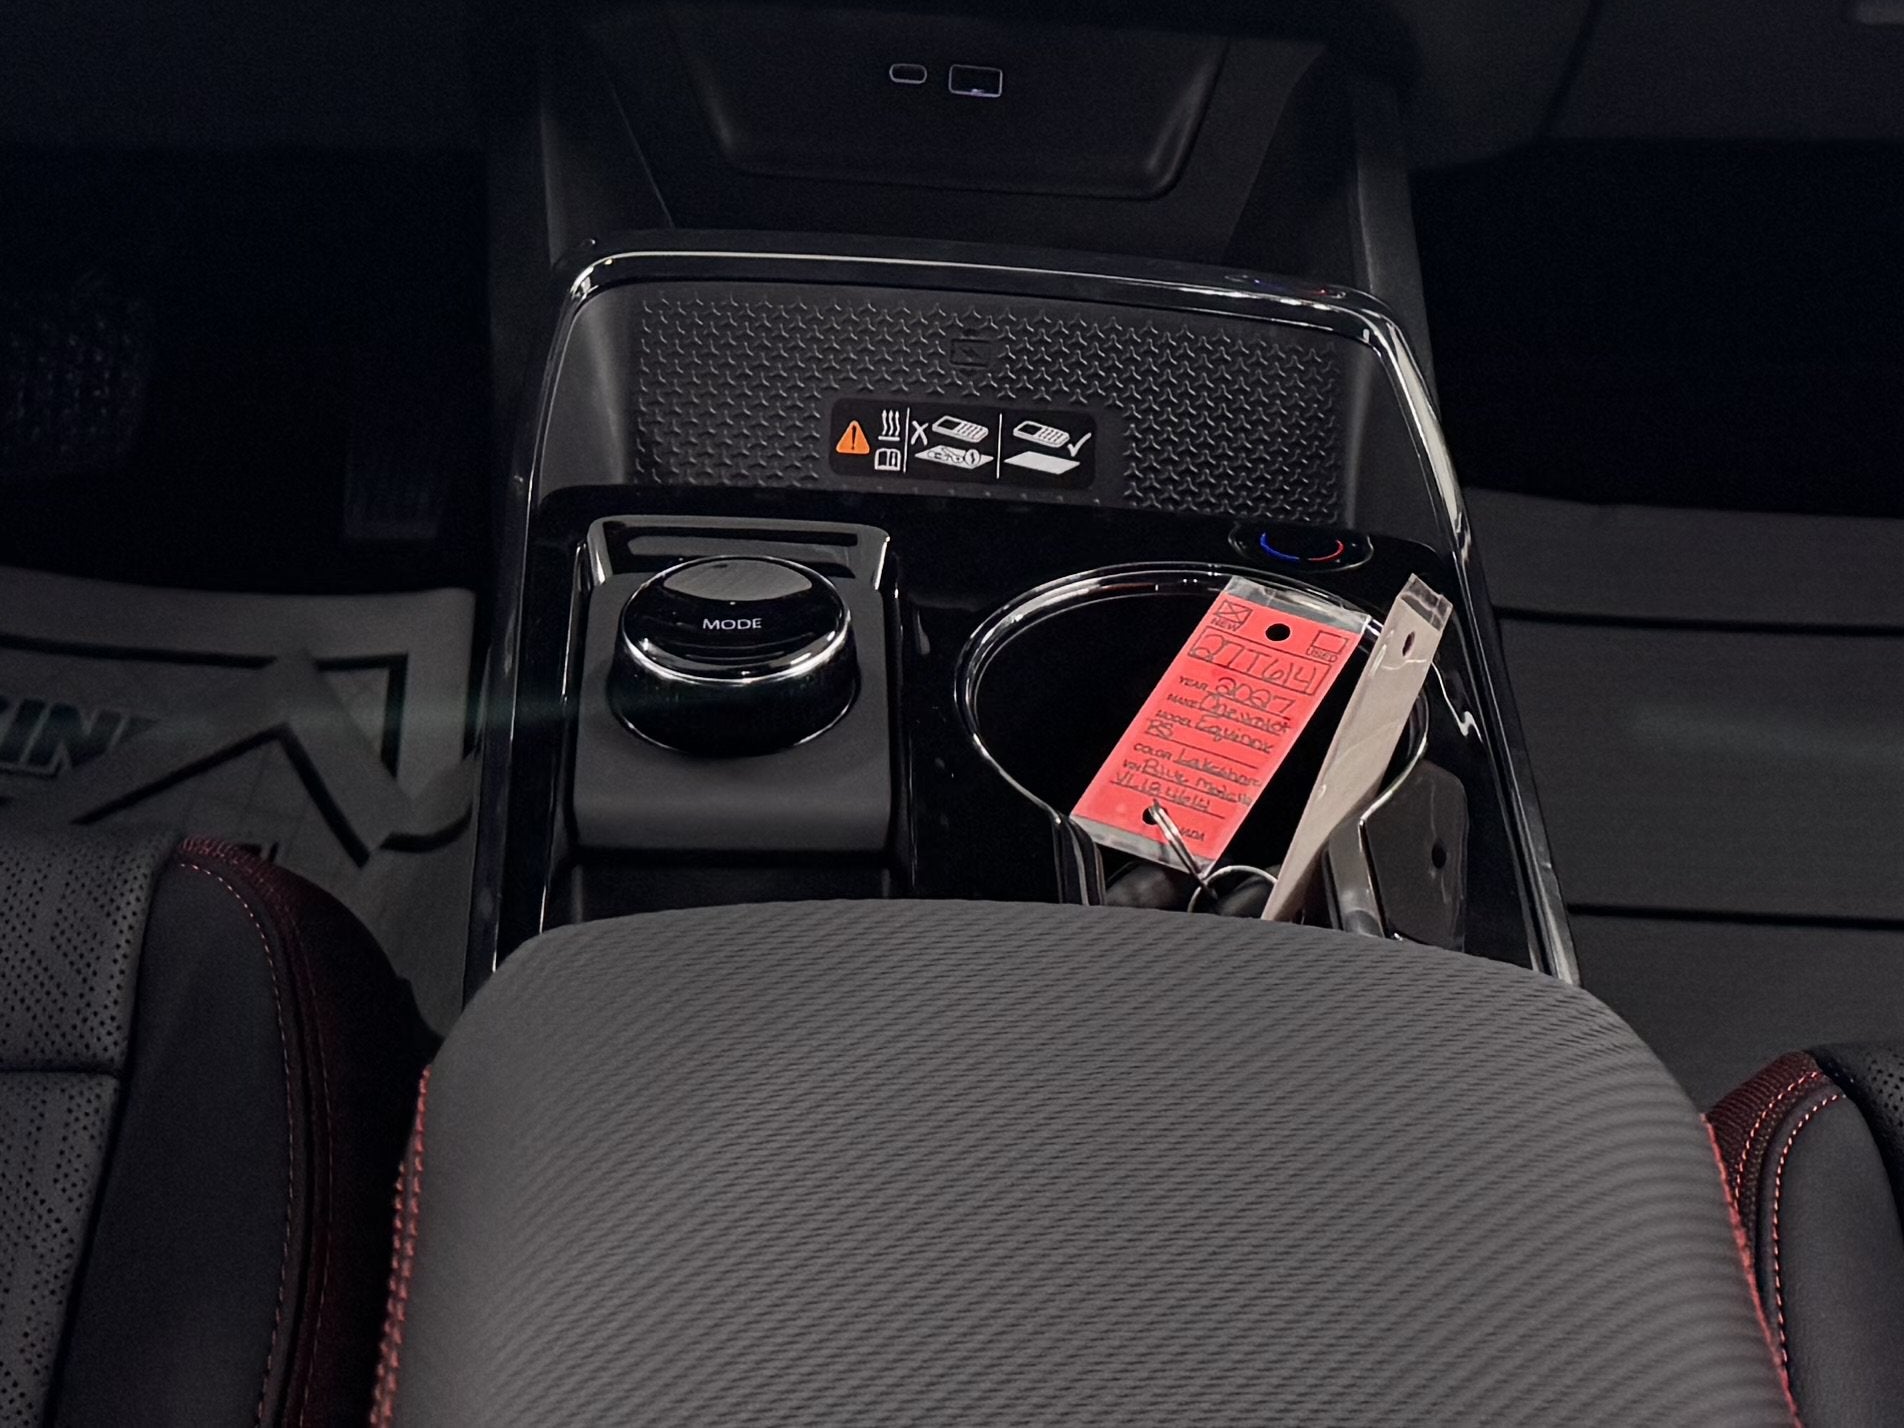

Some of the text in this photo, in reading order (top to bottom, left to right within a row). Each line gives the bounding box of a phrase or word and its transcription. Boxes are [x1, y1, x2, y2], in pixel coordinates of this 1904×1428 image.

[702, 616, 763, 631] MODE
[1211, 618, 1239, 632] NEW
[1179, 676, 1207, 692] YEAR
[1156, 710, 1191, 728] MODEL
[1133, 743, 1173, 761] COLOR
